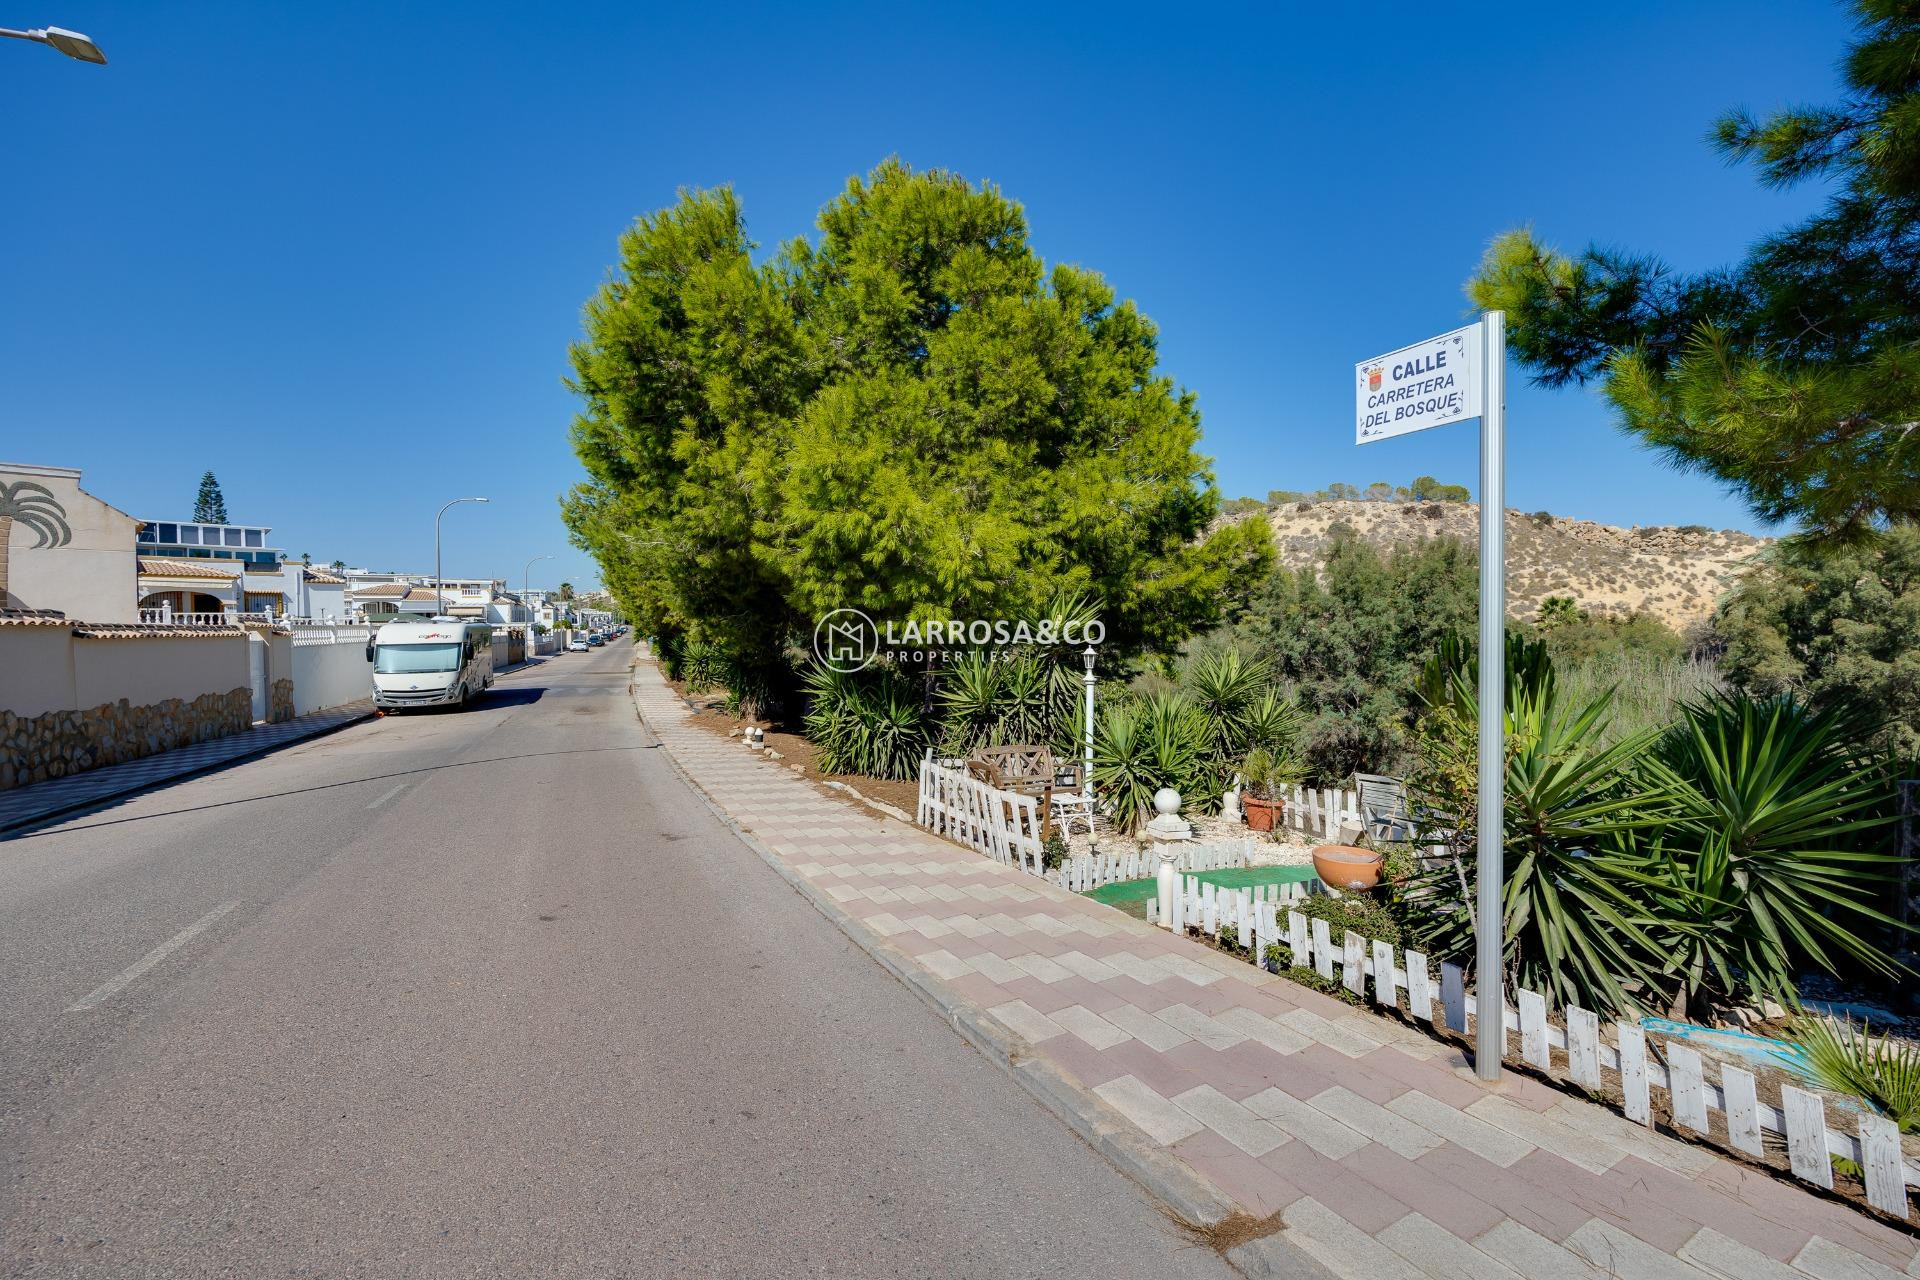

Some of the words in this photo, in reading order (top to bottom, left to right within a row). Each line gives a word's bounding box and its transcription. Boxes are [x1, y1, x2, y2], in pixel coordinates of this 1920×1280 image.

[1392, 351, 1447, 381] CALLE
[1368, 374, 1455, 409] CARRETERA
[1365, 411, 1391, 428] DEL
[1395, 392, 1458, 421] BOSQUE
